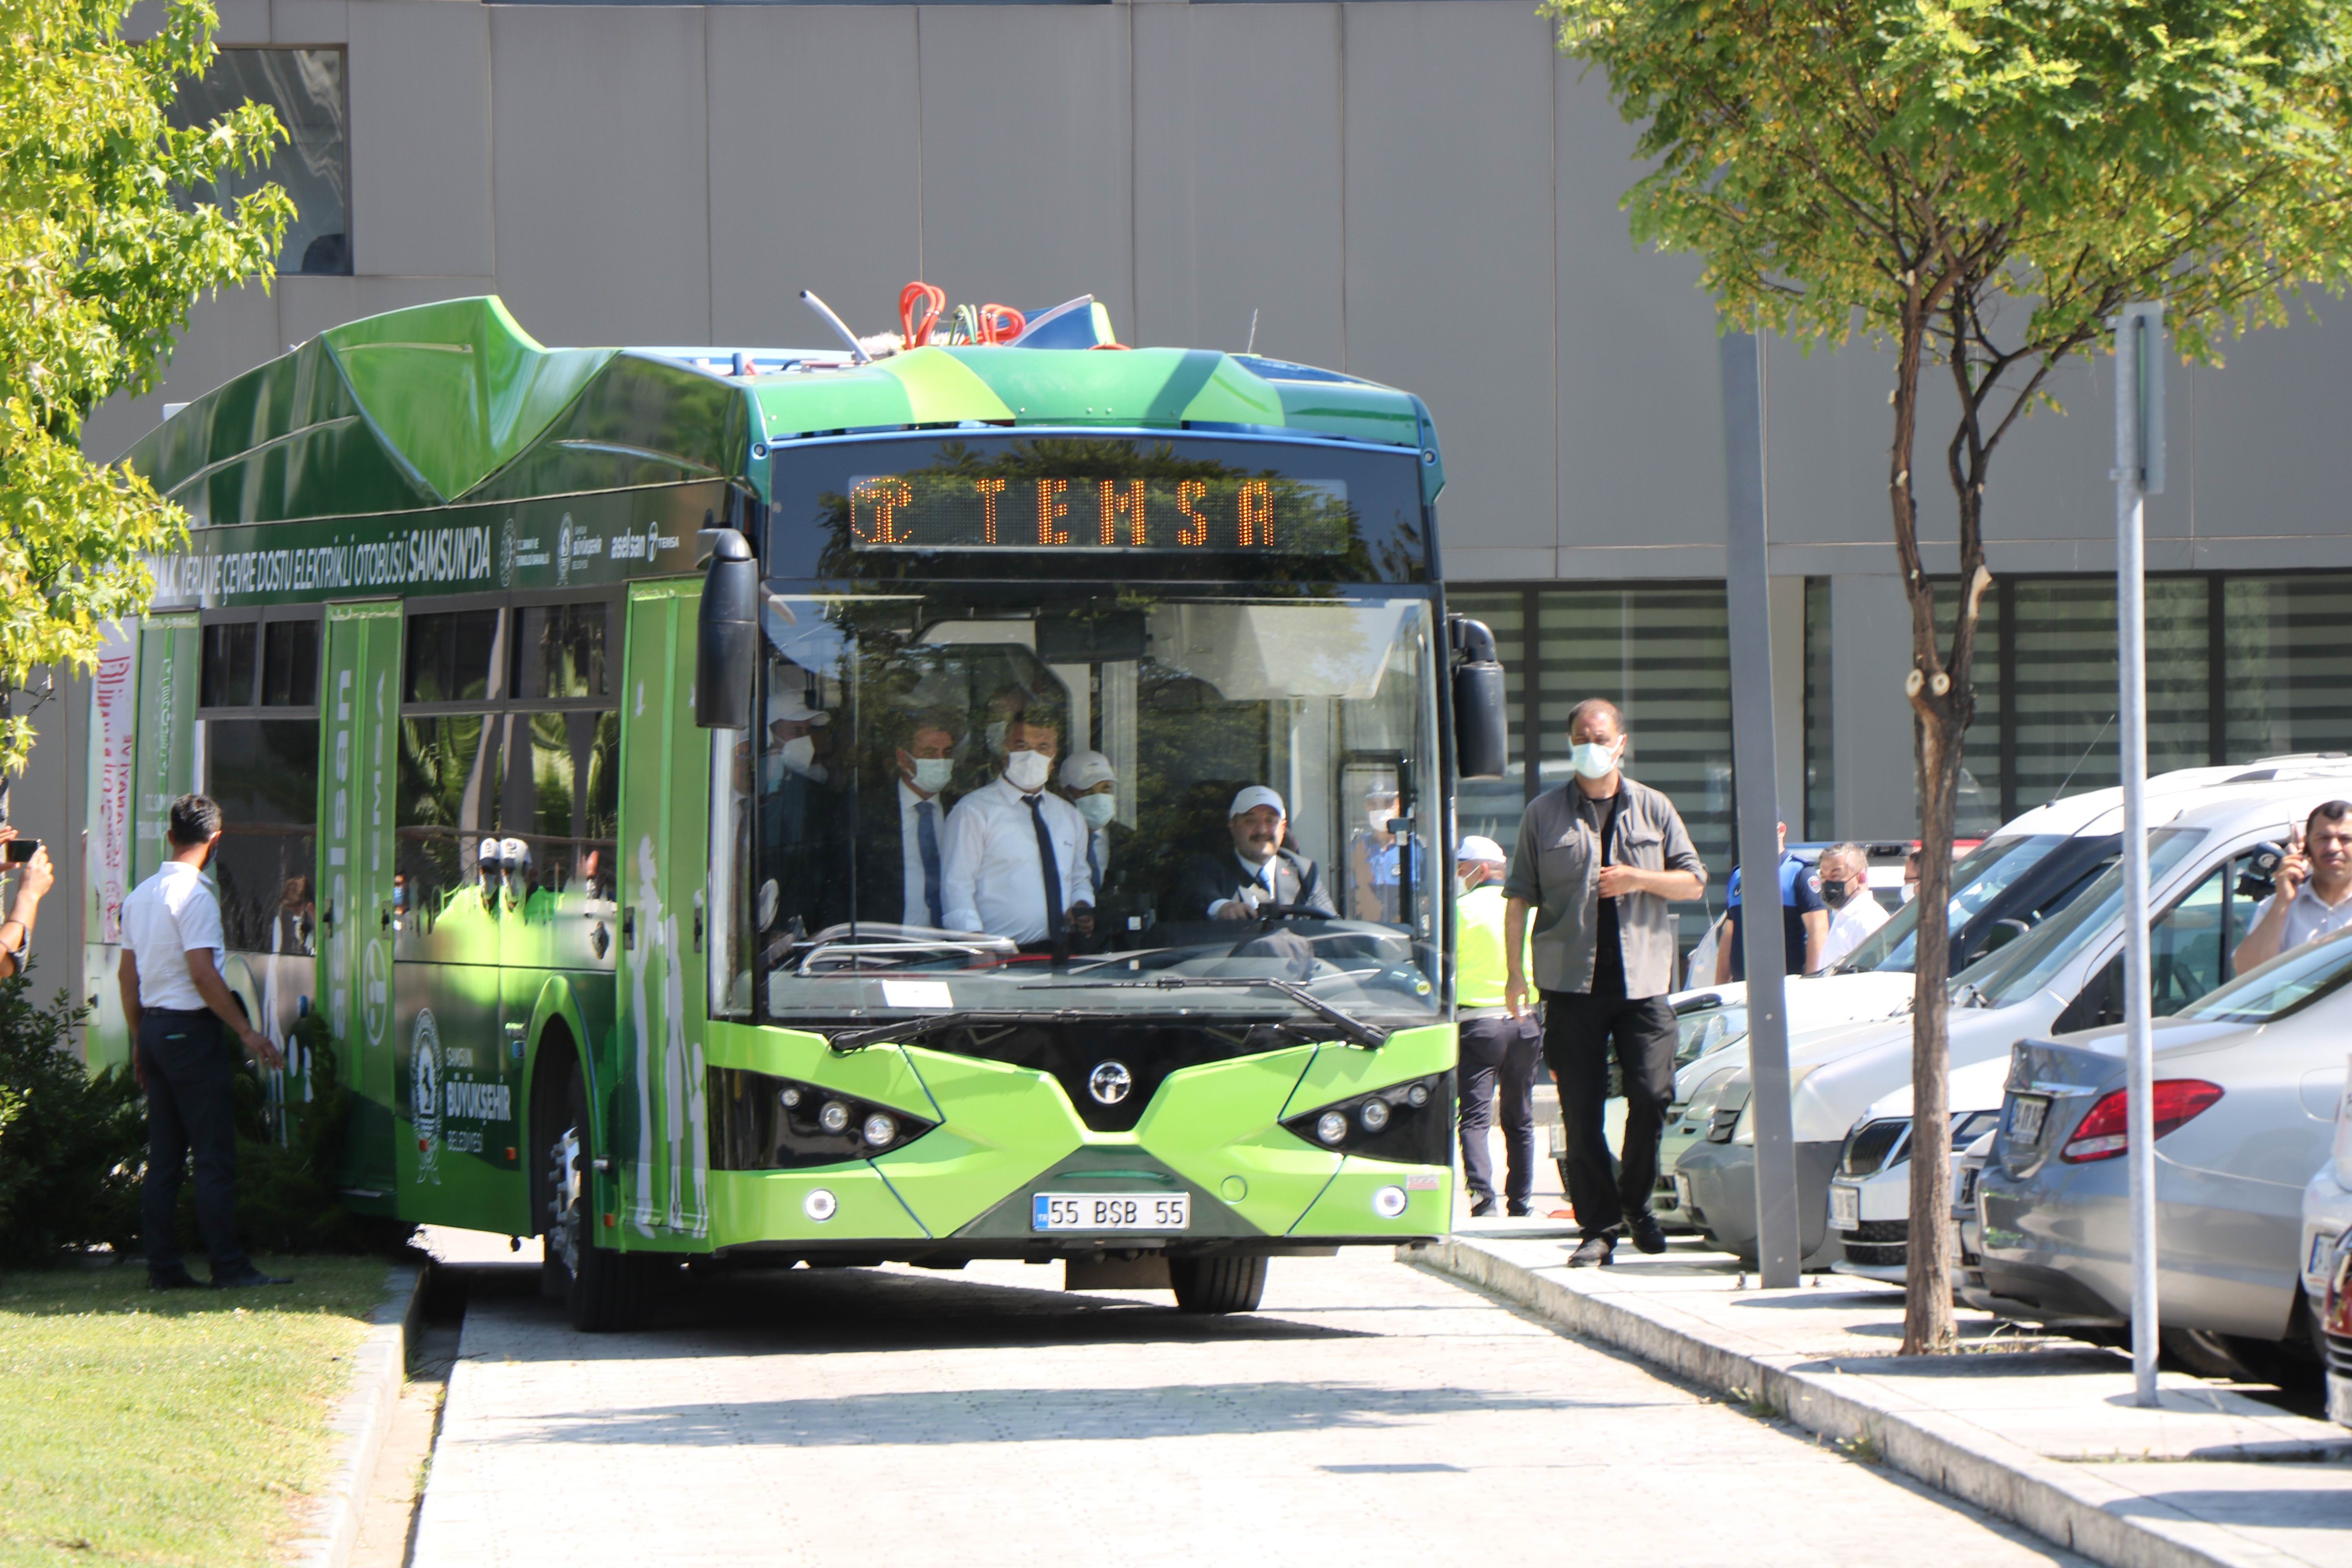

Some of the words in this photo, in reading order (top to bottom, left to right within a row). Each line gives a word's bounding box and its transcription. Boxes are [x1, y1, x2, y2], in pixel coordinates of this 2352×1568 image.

[657, 536, 679, 549] TEMSA
[976, 477, 1274, 546] TEMSA
[180, 545, 209, 596] YERLİ
[208, 554, 223, 595] VE
[222, 552, 257, 606] ÇEVRE
[257, 549, 294, 591] DOSTU
[293, 534, 355, 590] ELEKTRİKLİ
[354, 530, 409, 586] OTOBÜSÜ
[408, 526, 490, 583] SAMSUN'DA
[610, 527, 646, 559] aselsan
[371, 669, 385, 926] TEMSA
[330, 669, 352, 1041] aselsan
[446, 1072, 512, 1127] BÜYÜKŞEHİR
[1051, 1201, 1079, 1223] 55
[1156, 1201, 1185, 1223] 55
